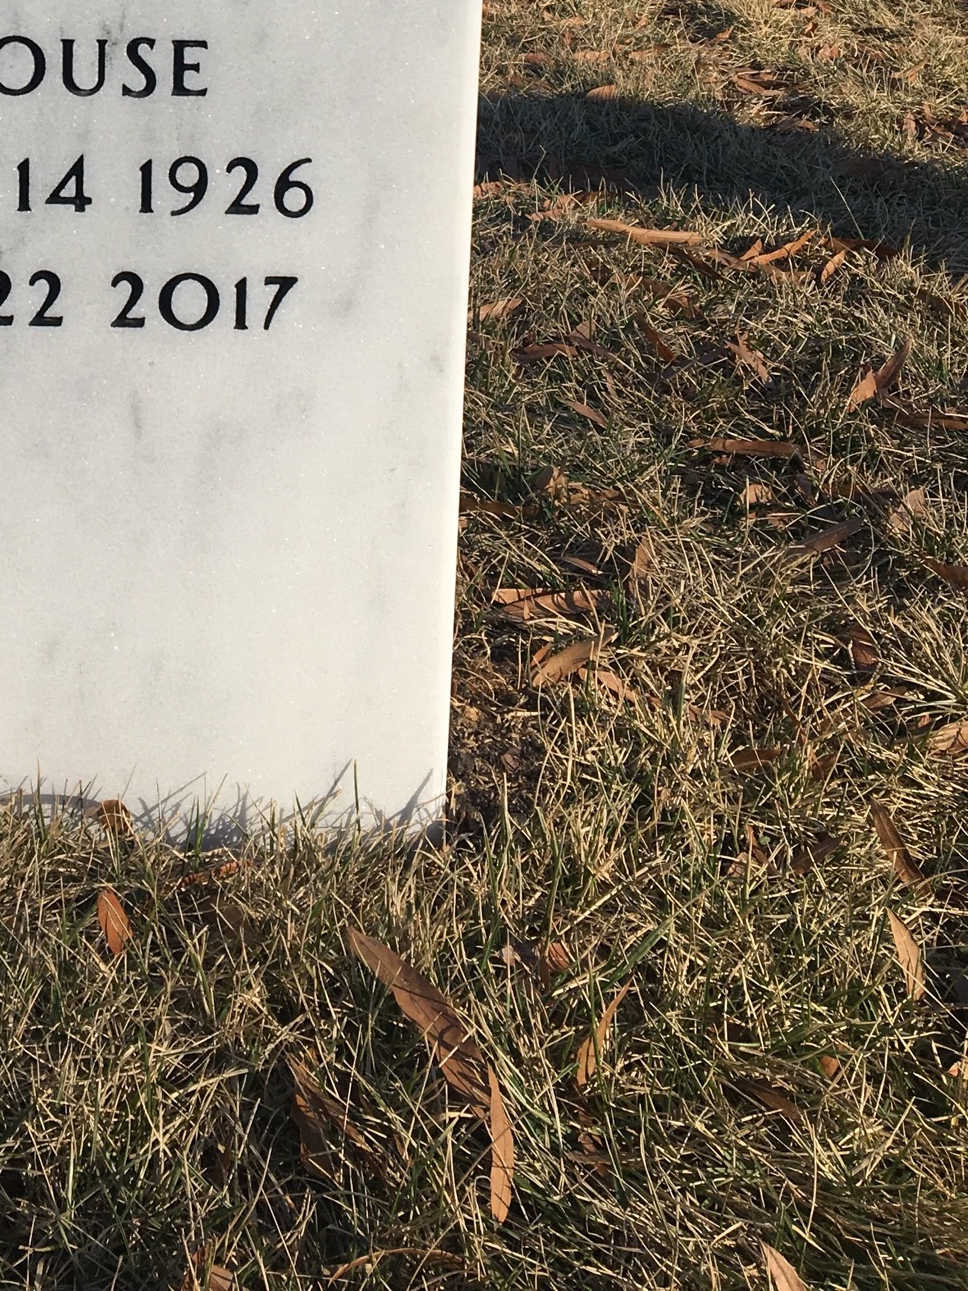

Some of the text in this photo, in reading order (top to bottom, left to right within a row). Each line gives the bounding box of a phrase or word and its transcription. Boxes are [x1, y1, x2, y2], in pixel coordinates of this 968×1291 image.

[16, 153, 93, 213] 14
[138, 155, 314, 219] 1926
[110, 270, 299, 332] 2017
